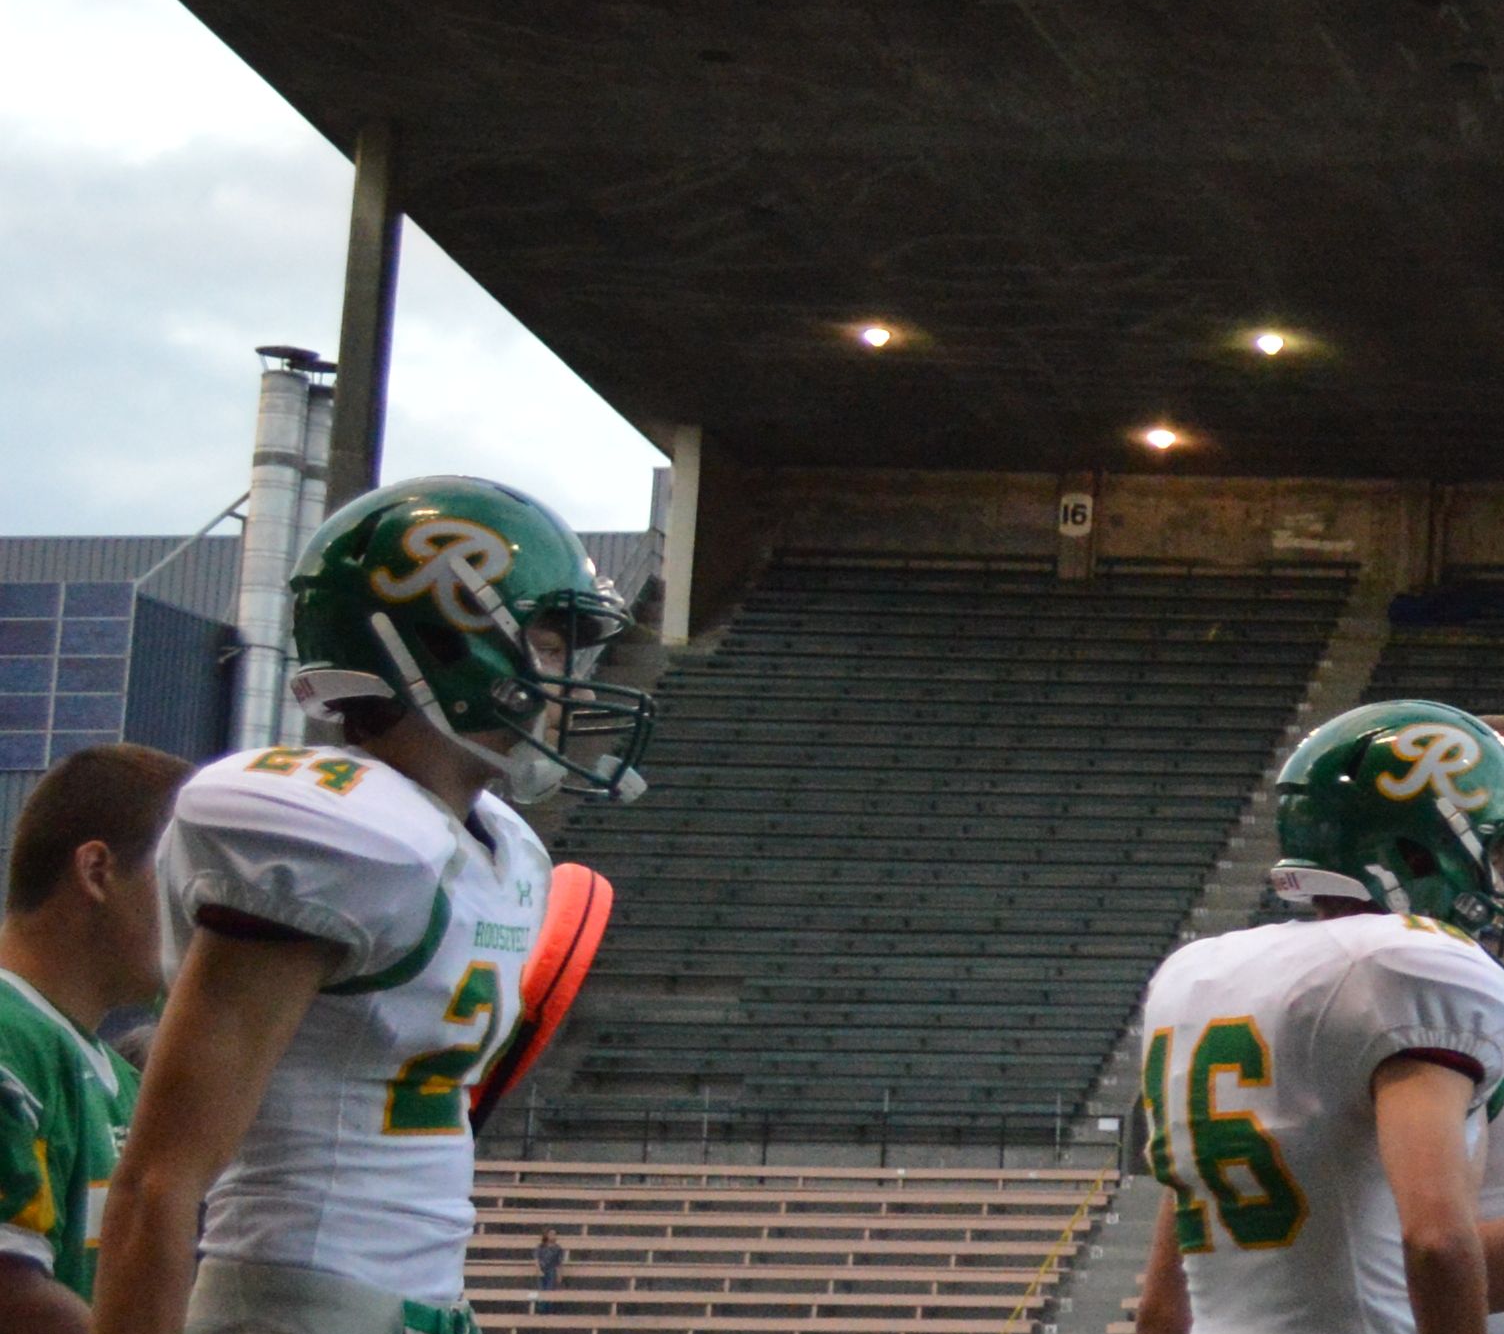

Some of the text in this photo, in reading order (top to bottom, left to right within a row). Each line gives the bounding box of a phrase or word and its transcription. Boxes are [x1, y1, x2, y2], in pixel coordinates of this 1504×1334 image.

[1063, 504, 1088, 525] 16
[244, 745, 373, 797] 24
[1143, 1014, 1311, 1254] 16
